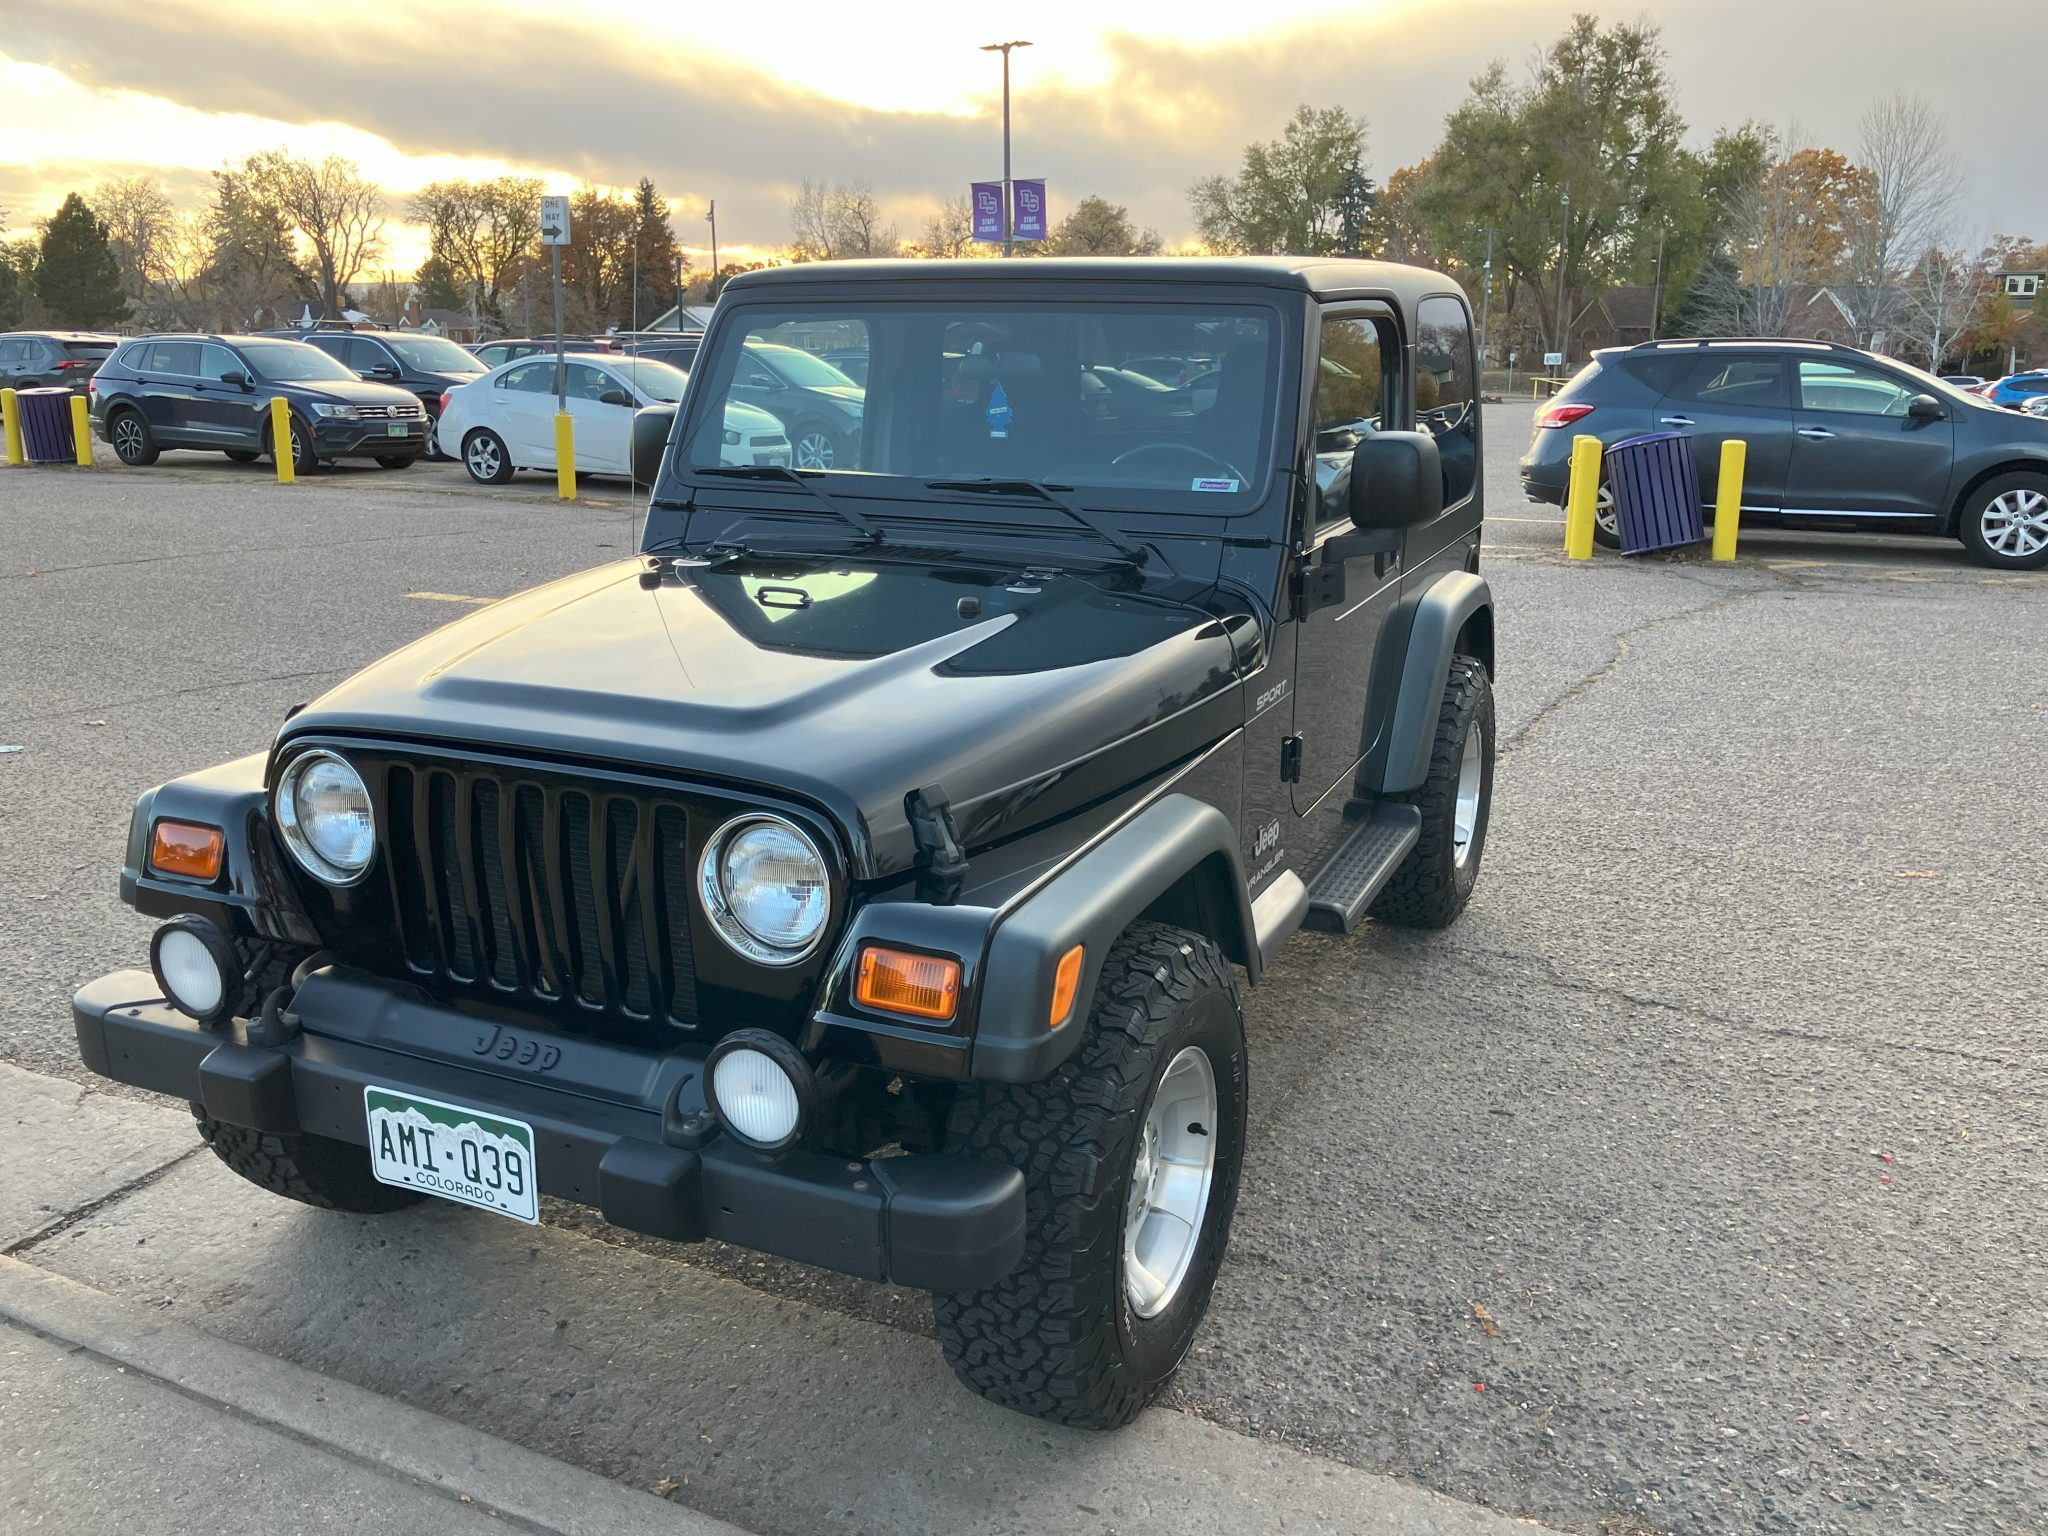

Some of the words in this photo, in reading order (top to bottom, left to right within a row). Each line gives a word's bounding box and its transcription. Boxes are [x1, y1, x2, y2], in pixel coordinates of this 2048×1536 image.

[544, 200, 560, 208] ONE
[544, 213, 560, 221] WAY
[1255, 679, 1288, 712] SPORT
[1254, 817, 1280, 857] Jeep
[472, 1025, 562, 1074] Jeep
[416, 1172, 495, 1203] COLORADO
